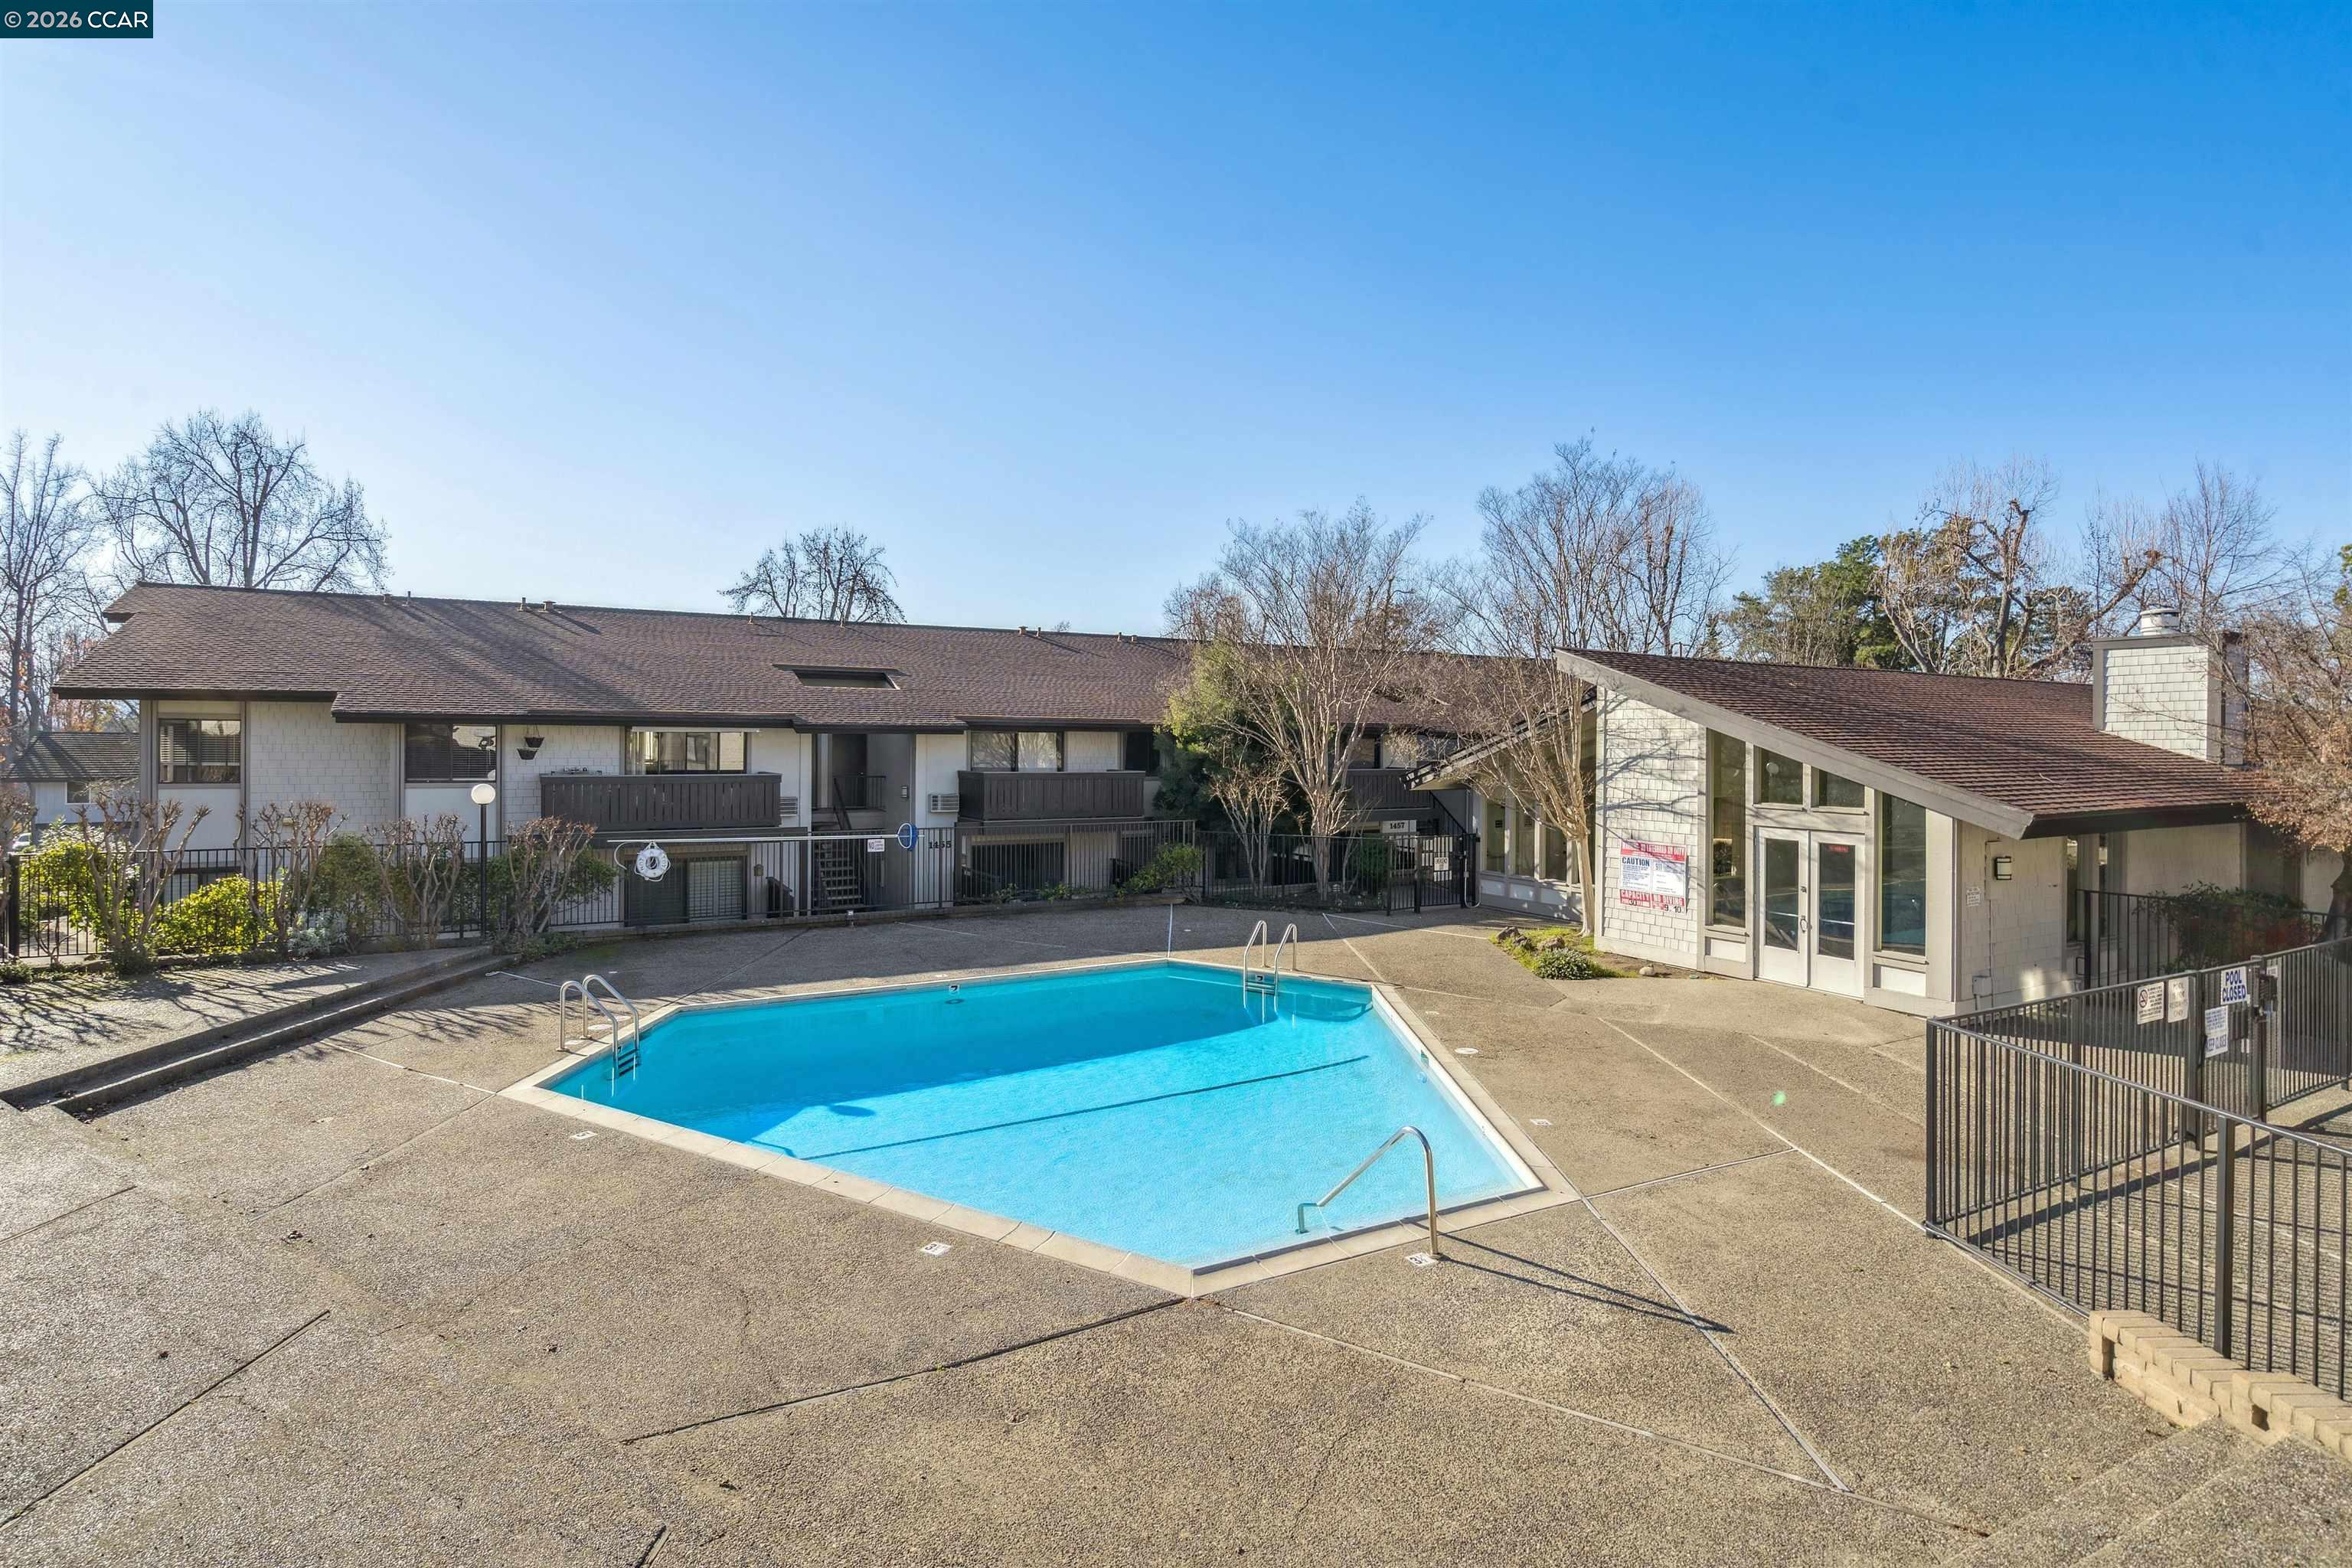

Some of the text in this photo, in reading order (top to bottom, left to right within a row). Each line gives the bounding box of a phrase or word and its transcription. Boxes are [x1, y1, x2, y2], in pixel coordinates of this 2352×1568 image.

[1622, 856, 1650, 867] CAUTION
[1621, 889, 1649, 902] CAPACITY
[1662, 895, 1684, 907] DIVING
[2225, 969, 2243, 986] POOL
[2223, 985, 2246, 1002] CLOSED
